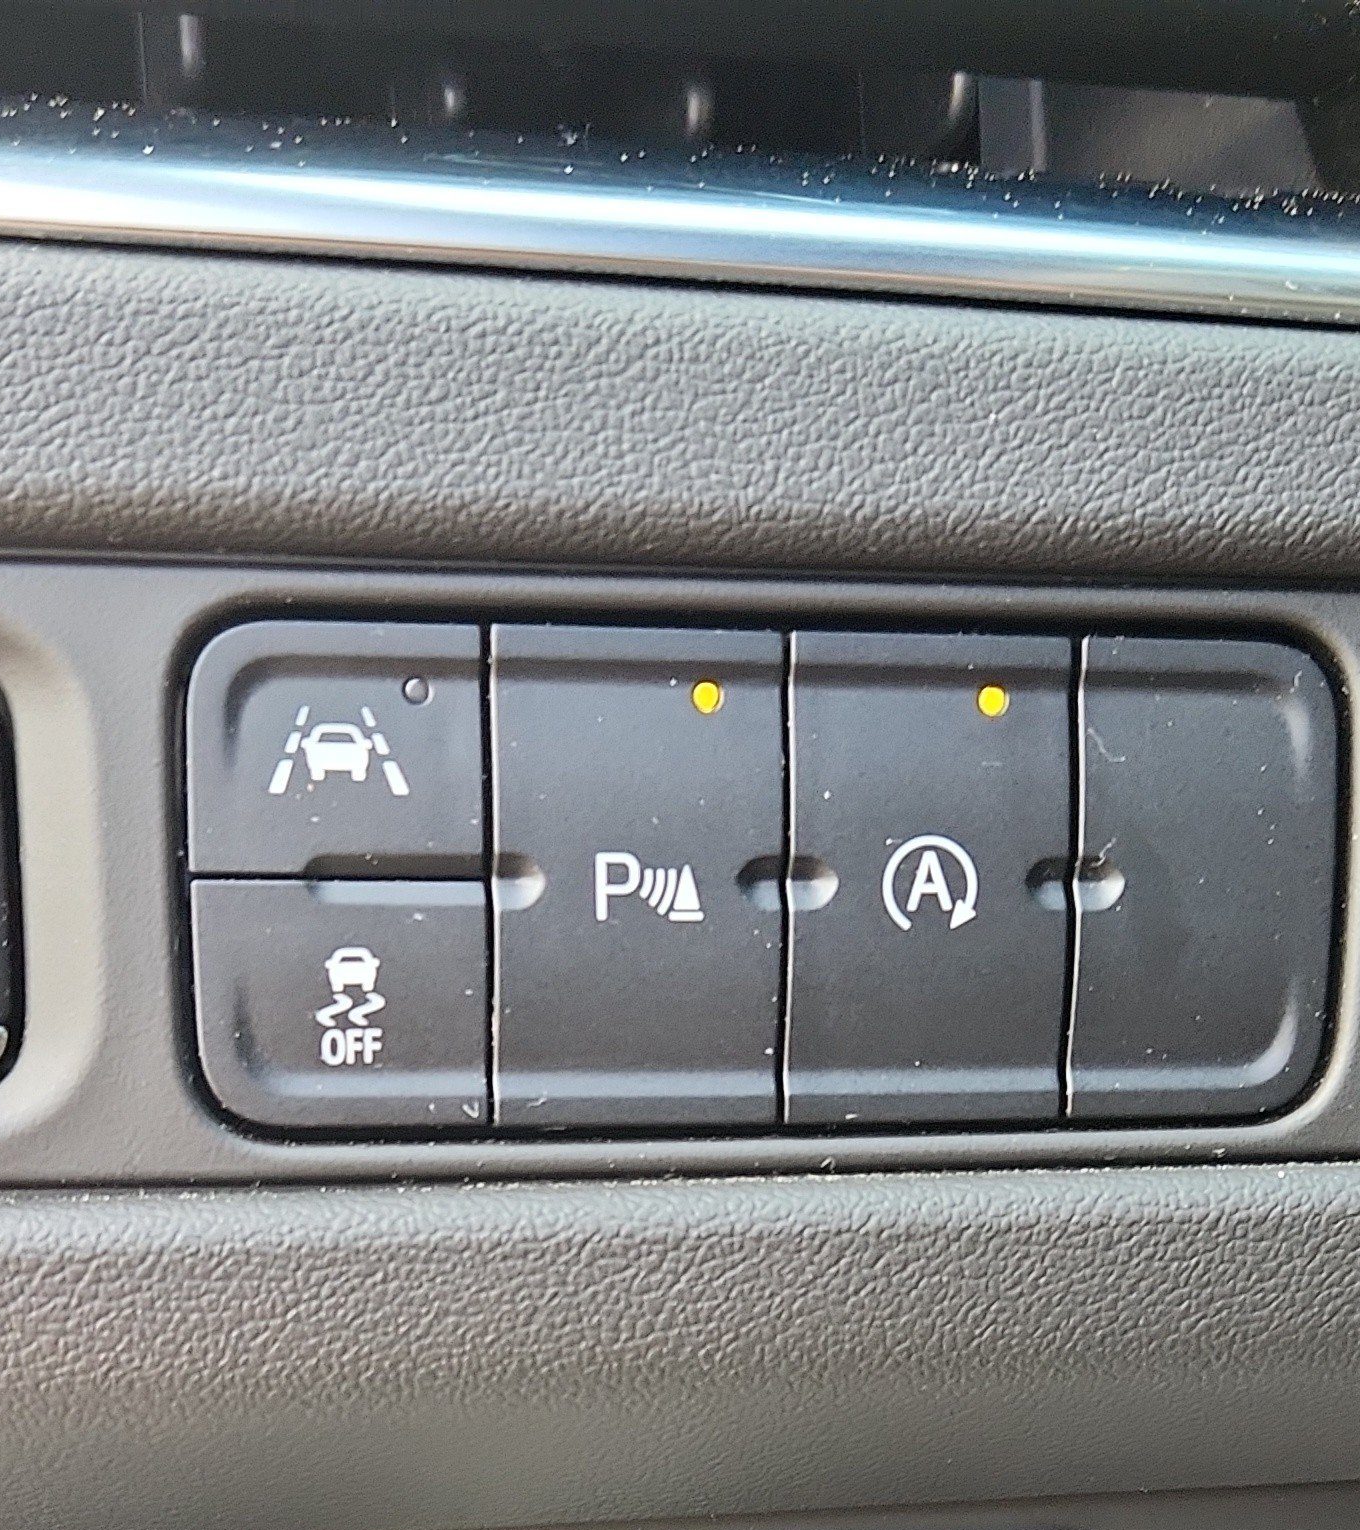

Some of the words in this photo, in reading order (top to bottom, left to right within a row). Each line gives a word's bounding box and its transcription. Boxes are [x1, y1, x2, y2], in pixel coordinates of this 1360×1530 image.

[594, 851, 641, 922] P
[906, 850, 953, 913] A
[321, 1027, 383, 1067] OFF
